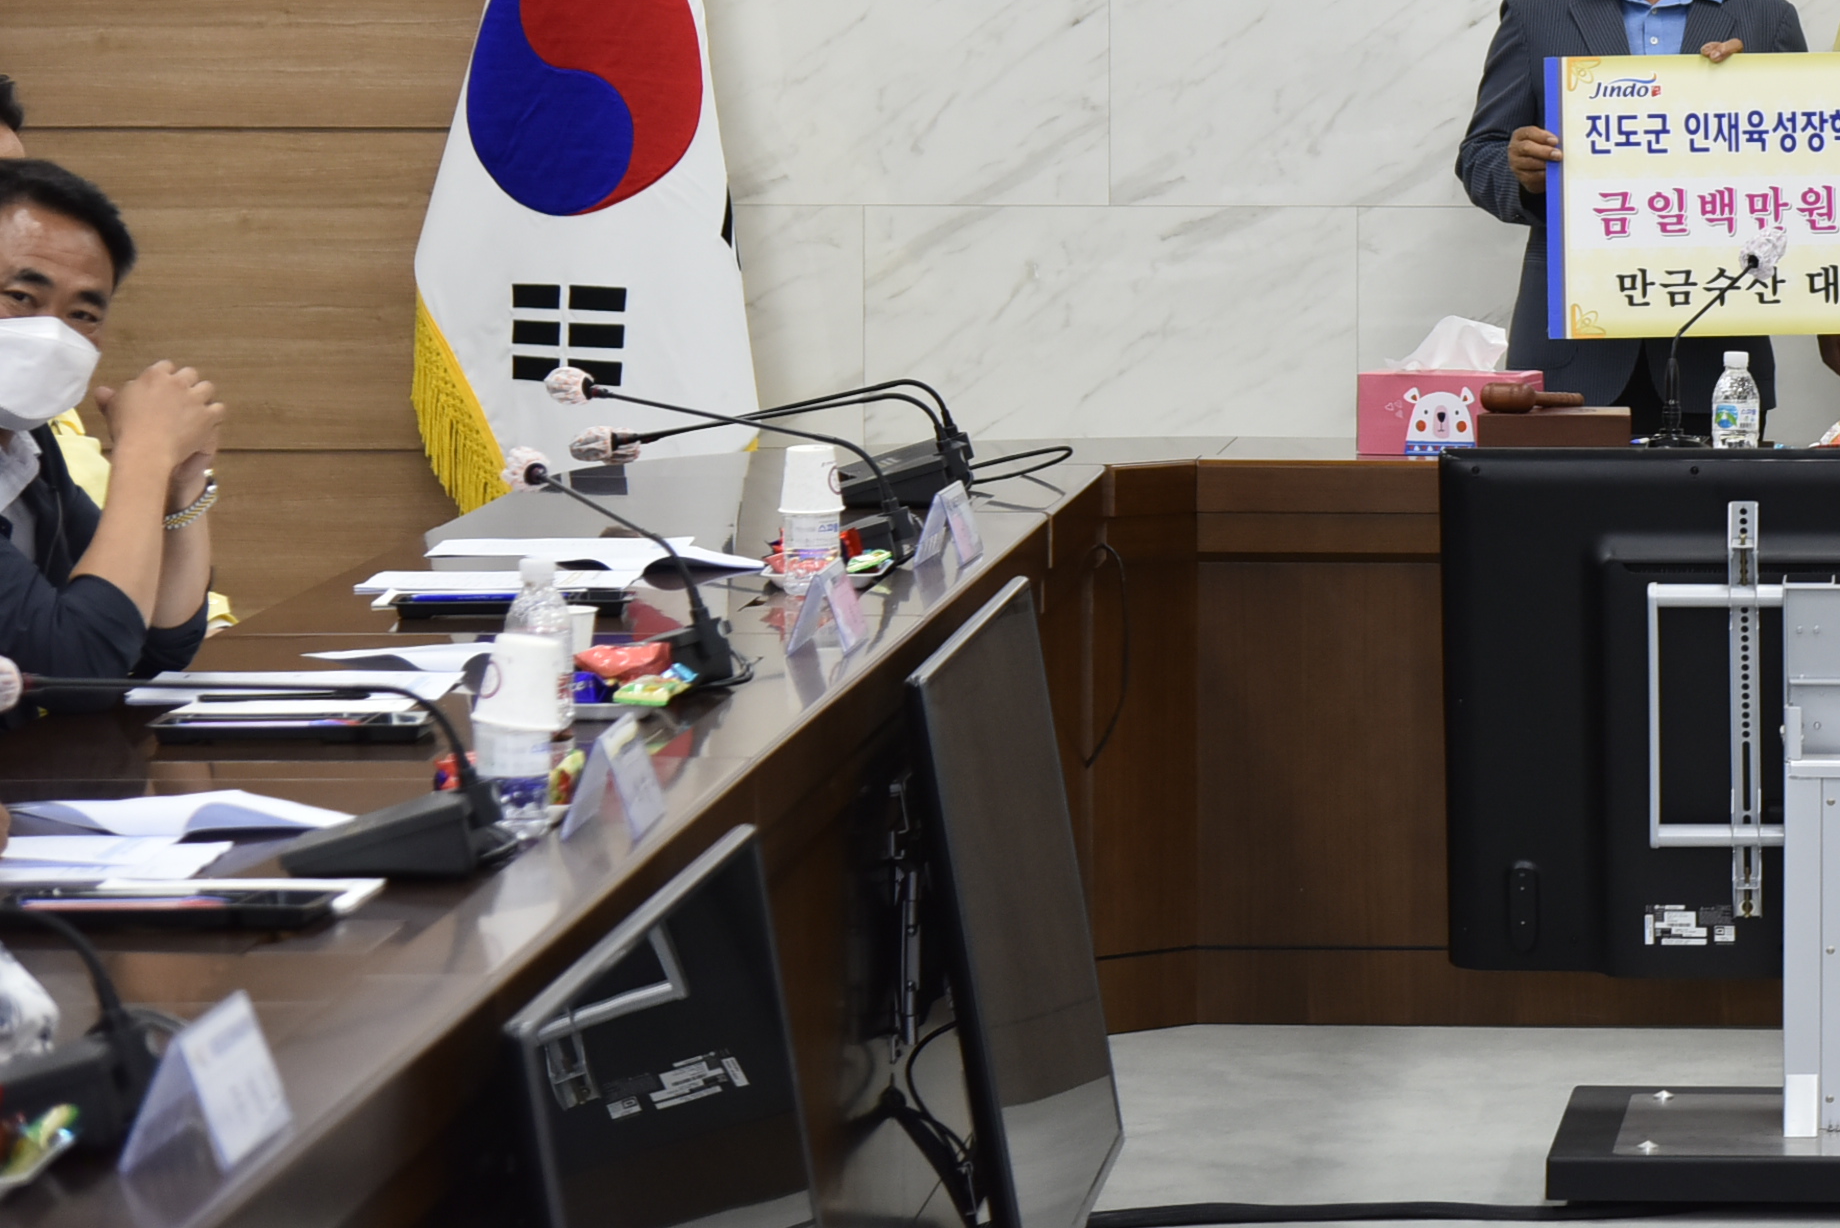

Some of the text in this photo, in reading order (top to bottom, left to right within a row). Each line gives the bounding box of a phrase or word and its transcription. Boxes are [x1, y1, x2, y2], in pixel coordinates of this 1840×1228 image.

[1588, 81, 1650, 100] Jindo
[1586, 113, 1671, 155] 진도군
[1616, 265, 1787, 308] 만금수산
